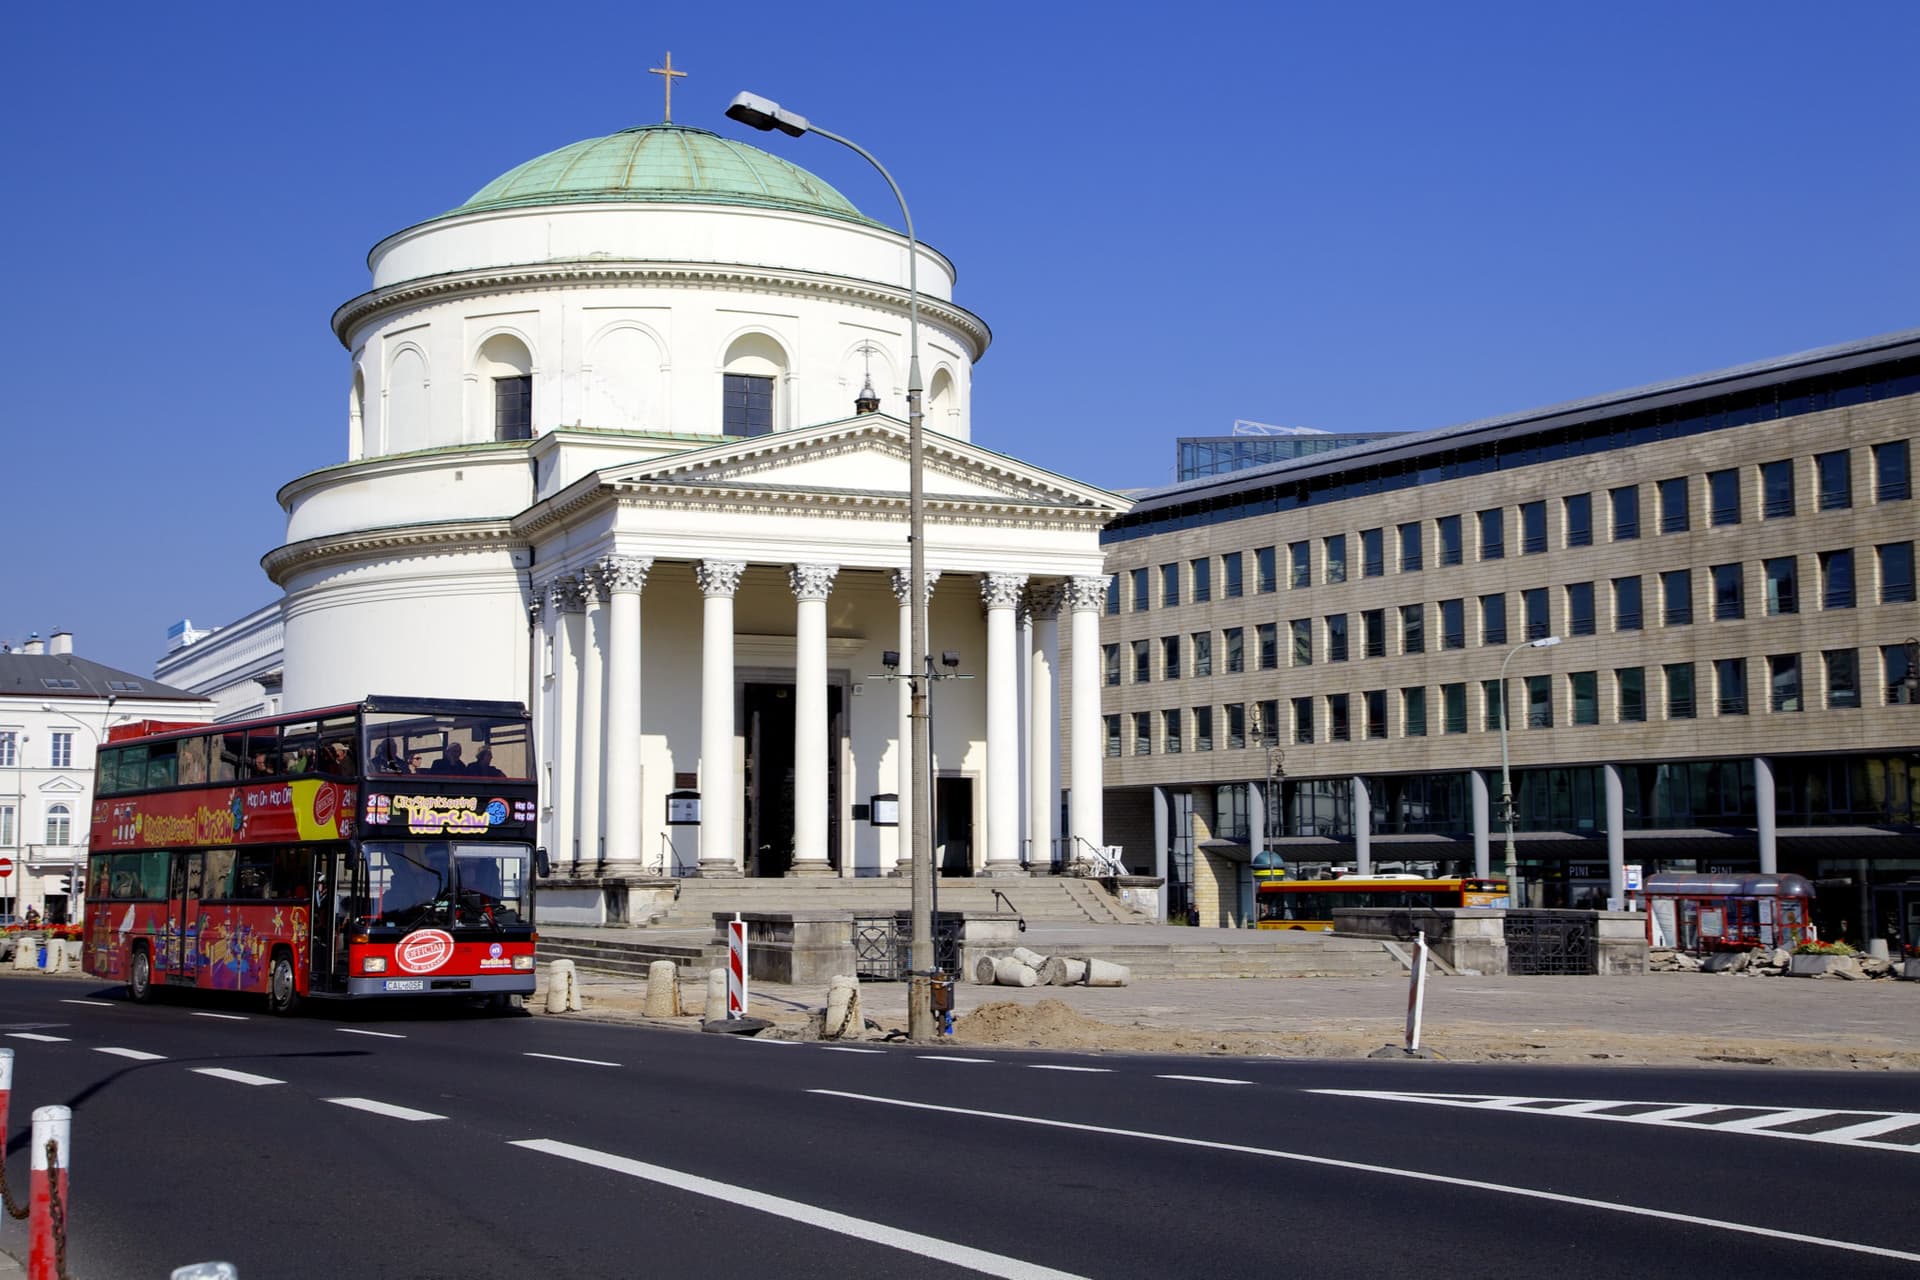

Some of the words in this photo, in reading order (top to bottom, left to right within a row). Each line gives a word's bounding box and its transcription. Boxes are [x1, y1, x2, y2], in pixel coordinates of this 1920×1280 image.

[247, 792, 258, 808] Hop
[260, 790, 268, 806] On
[270, 791, 281, 806] Hop
[282, 787, 293, 804] Off
[408, 807, 489, 834] Warsaw
[1569, 866, 1589, 876] PINI
[406, 942, 443, 959] OFFICIAL
